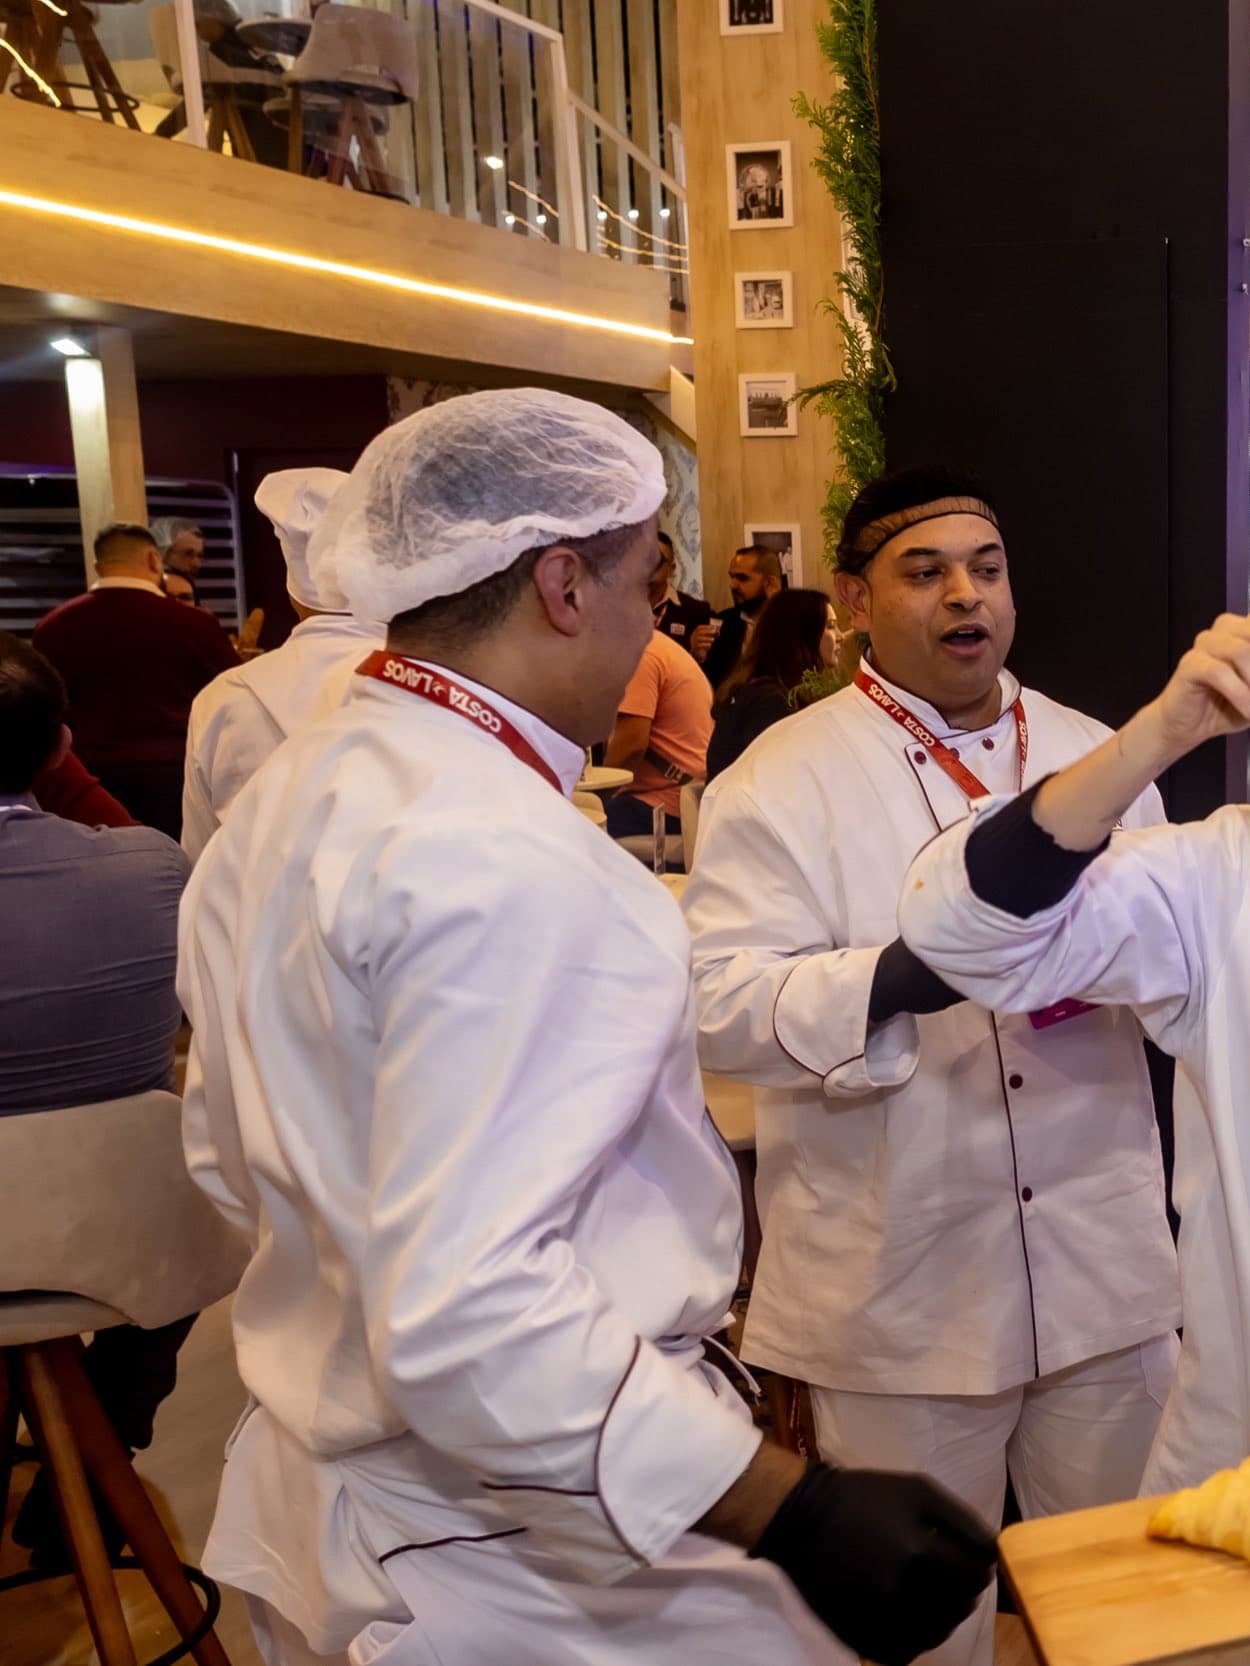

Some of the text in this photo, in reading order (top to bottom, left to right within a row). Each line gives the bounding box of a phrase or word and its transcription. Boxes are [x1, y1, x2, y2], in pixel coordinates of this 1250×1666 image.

[383, 659, 502, 733] COSTA LAVOS
[868, 683, 935, 747] COSTA LAVOS
